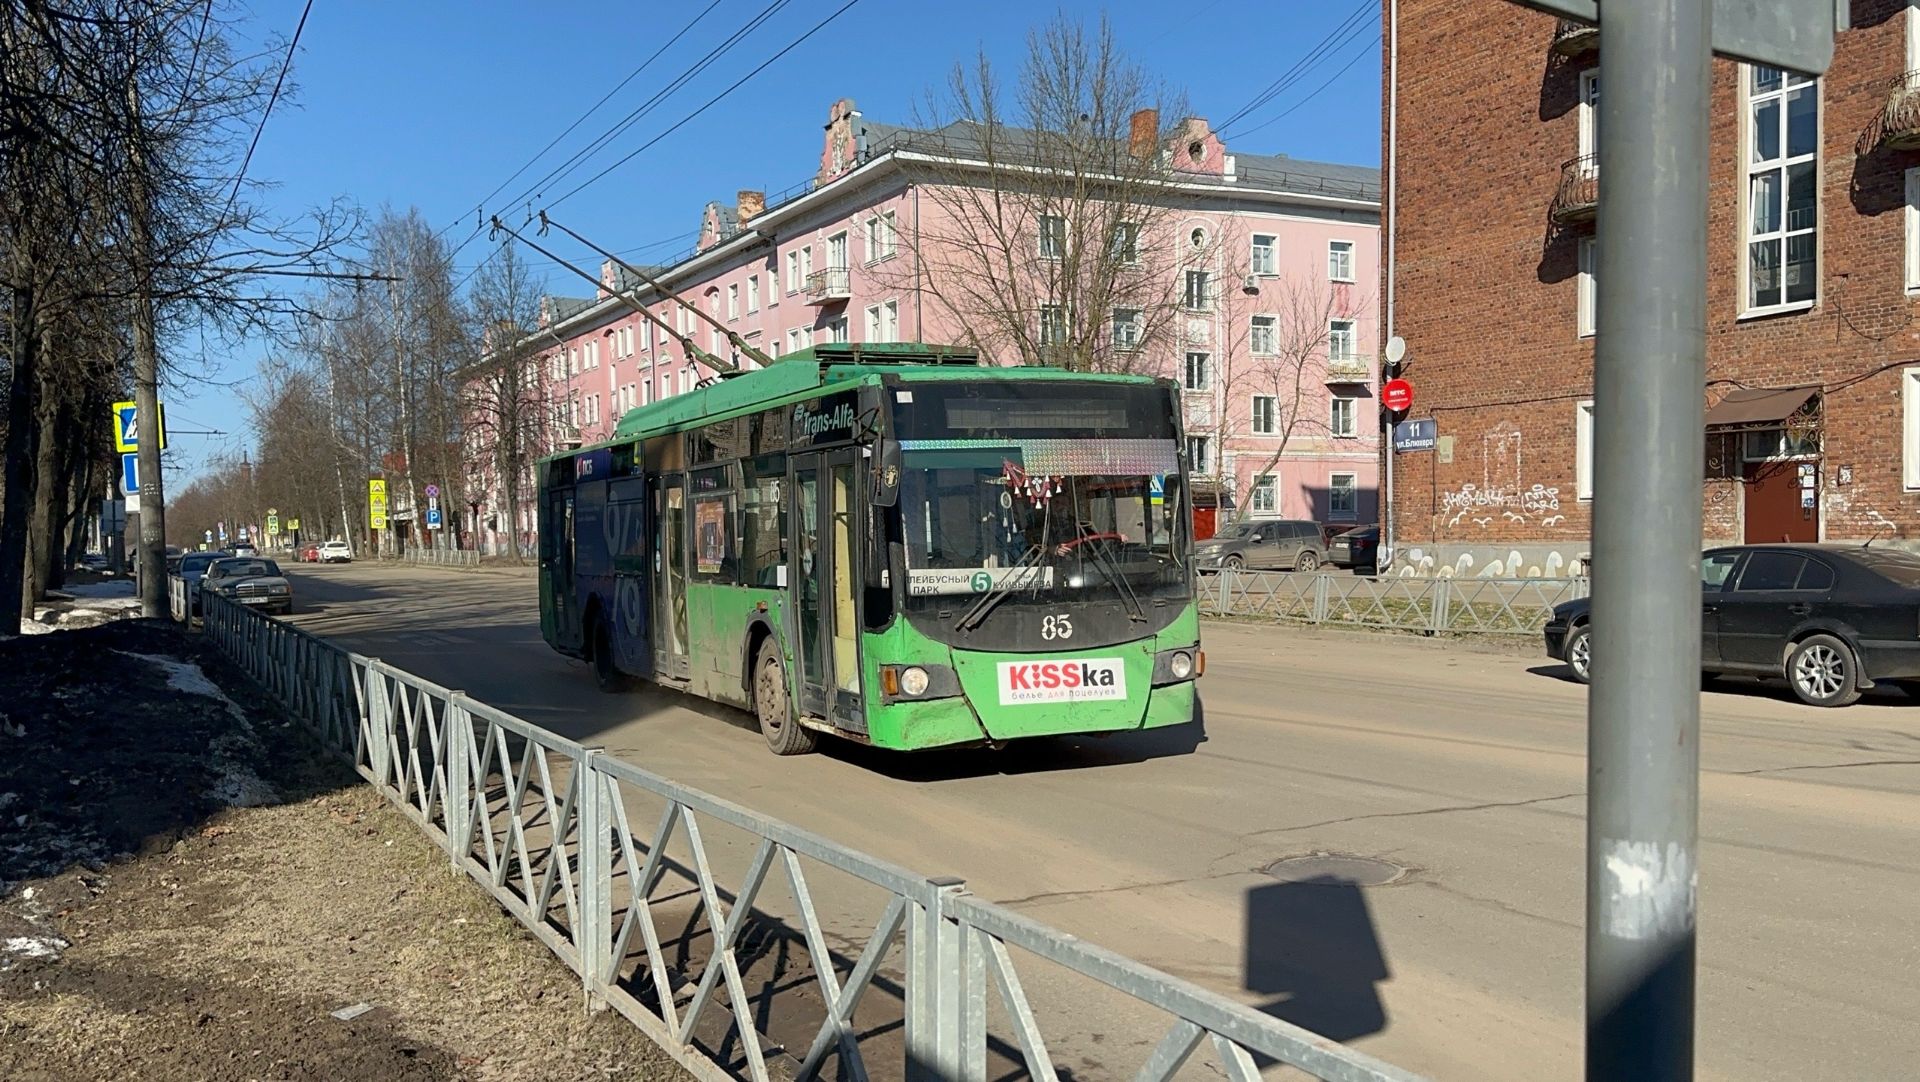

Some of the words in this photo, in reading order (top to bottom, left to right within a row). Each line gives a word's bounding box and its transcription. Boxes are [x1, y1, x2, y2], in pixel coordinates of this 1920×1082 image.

[803, 402, 854, 435] Trans-Alfa
[1409, 422, 1420, 437] 11
[583, 459, 593, 475] ПСБ
[769, 480, 780, 503] 85
[430, 512, 438, 522] P
[913, 586, 940, 594] ПАРК
[975, 573, 988, 592] 5
[1041, 613, 1073, 641] 85
[1011, 690, 1043, 700] белье
[1047, 690, 1065, 699] для
[1068, 688, 1116, 699] поцелуев
